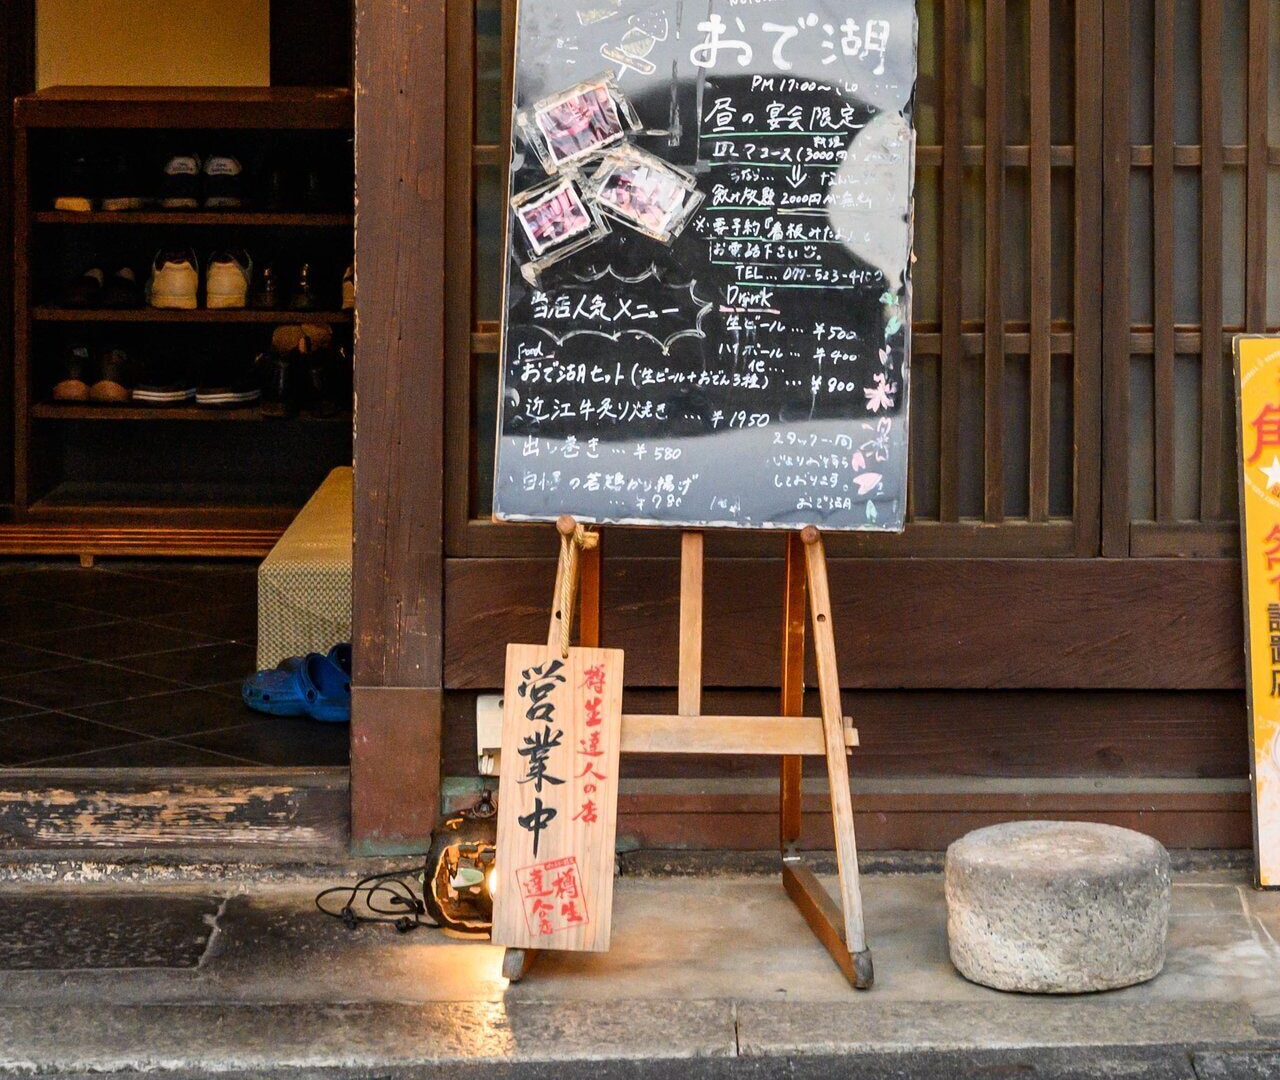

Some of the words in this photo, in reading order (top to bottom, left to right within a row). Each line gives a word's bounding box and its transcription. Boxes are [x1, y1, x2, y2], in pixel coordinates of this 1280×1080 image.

[691, 13, 890, 75] おで湖
[751, 75, 774, 91] PM
[705, 97, 865, 131] 昼の宴会限定
[530, 291, 679, 320] 当店人気メニュー
[726, 285, 774, 308] Drink
[813, 323, 858, 340] ¥500
[813, 348, 858, 363] ¥400
[811, 375, 856, 394] ¥800
[525, 397, 669, 422] 近江牛炙り焼き
[711, 412, 771, 428] ¥1950
[634, 444, 683, 461] ¥580
[572, 663, 608, 824] 樽生達人の店
[516, 659, 567, 859] 営業中
